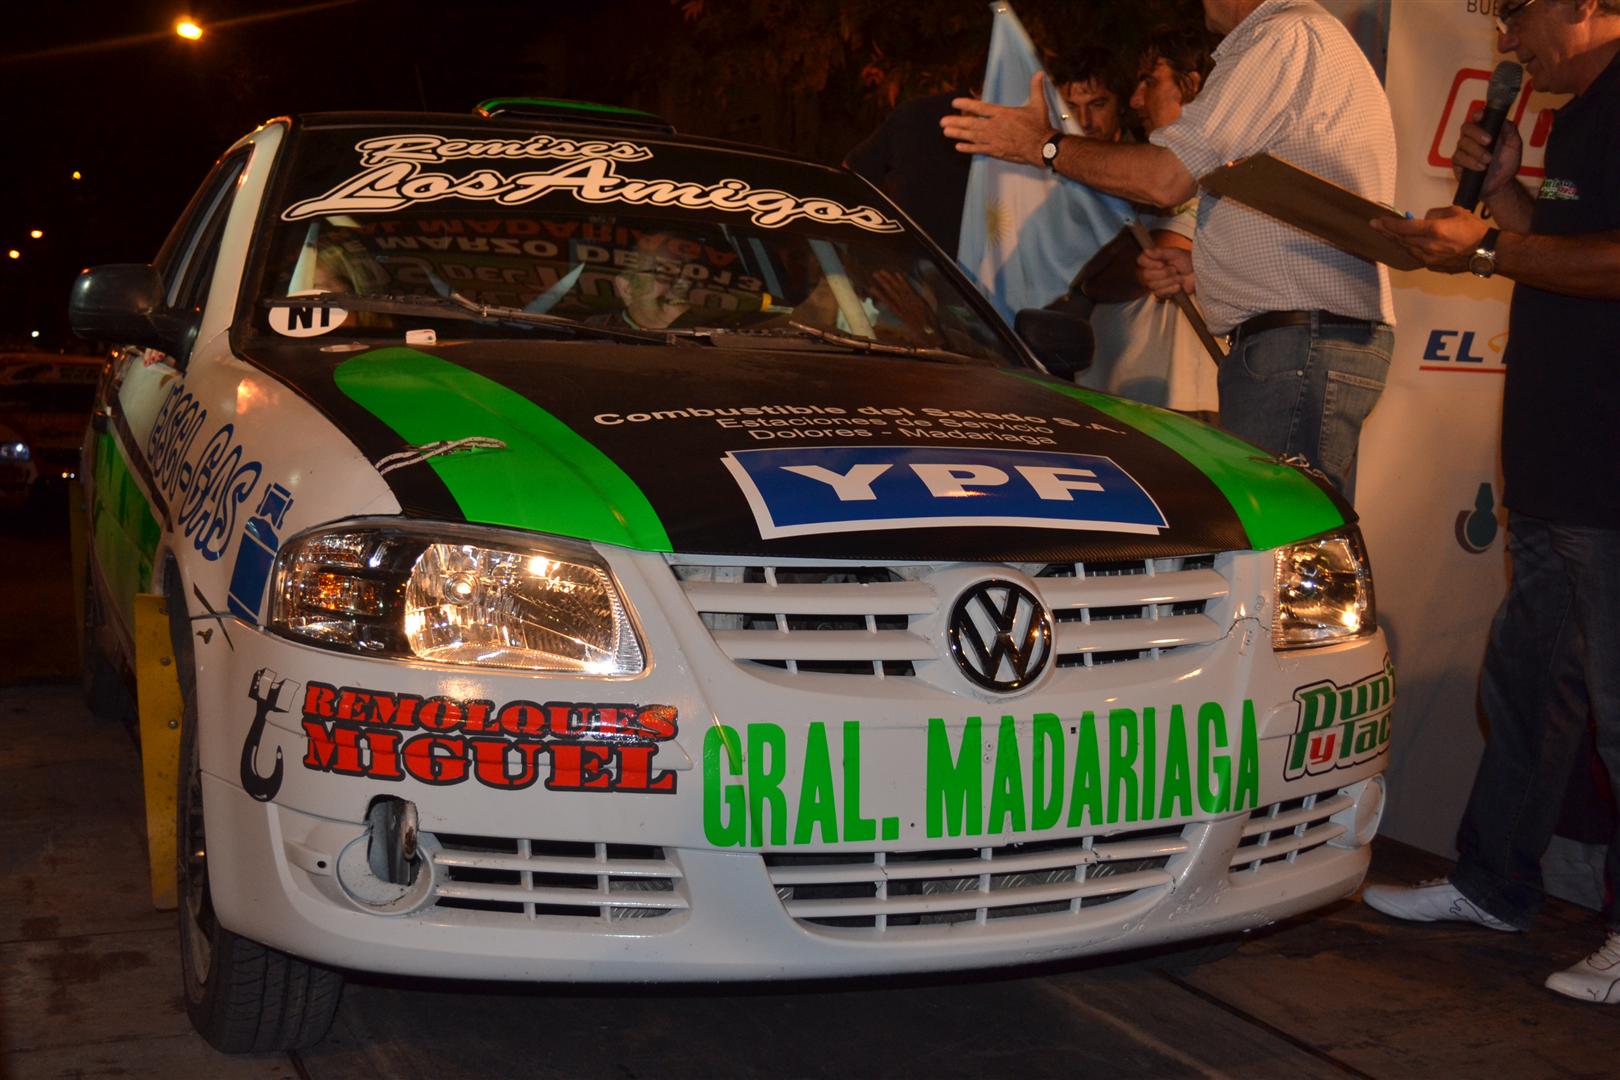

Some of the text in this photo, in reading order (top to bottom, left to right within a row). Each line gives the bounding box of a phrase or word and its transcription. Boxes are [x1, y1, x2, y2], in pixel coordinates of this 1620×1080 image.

[355, 134, 654, 168] Remises
[594, 405, 1128, 435] Combustible del Salado S.A.
[715, 416, 1055, 434] Estaciones de Servicio
[748, 428, 873, 440] Dolores
[898, 428, 1058, 446] Madariaga
[779, 463, 1106, 502] YPF
[302, 681, 678, 741] REMOLQUES
[302, 716, 677, 794] MIGUEL
[703, 698, 1260, 848] GRAL. MADARIAGA
